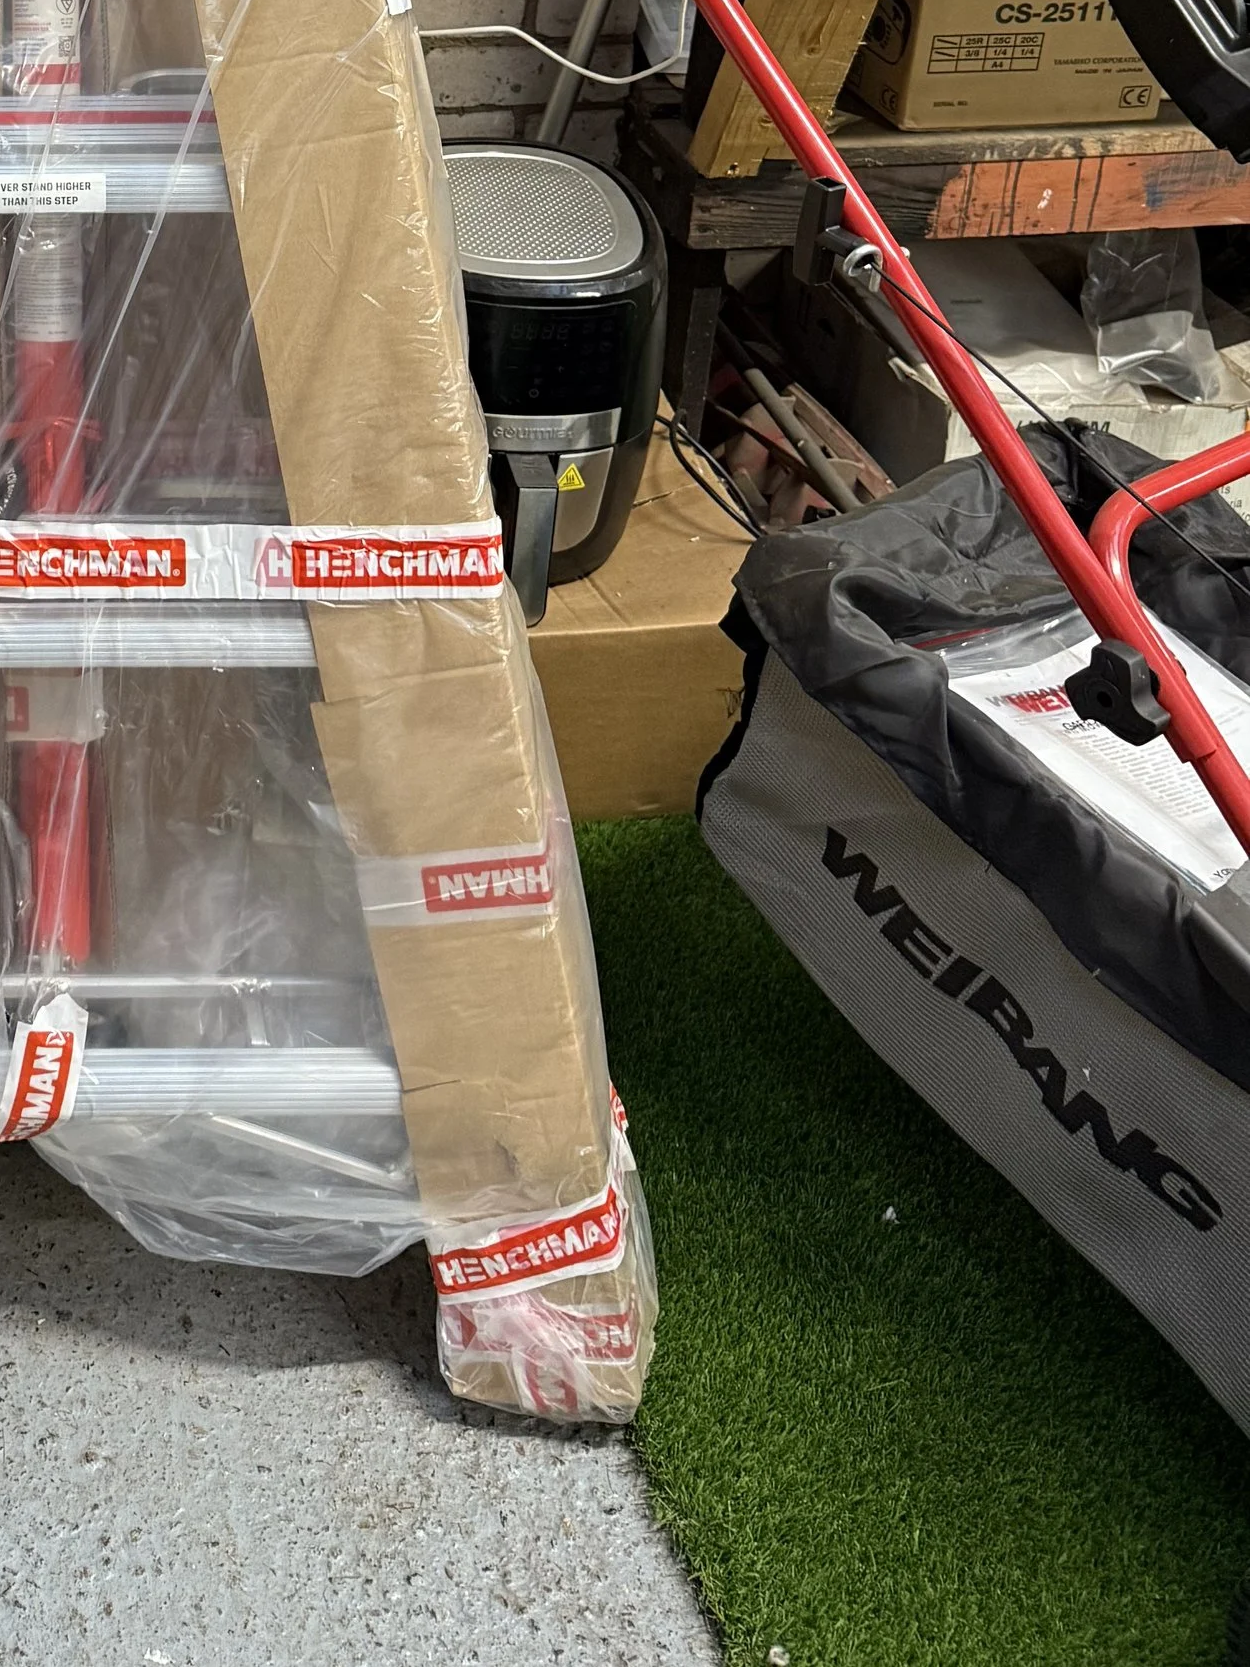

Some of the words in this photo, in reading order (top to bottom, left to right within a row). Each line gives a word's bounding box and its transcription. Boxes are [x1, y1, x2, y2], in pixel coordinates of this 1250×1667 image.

[995, 1, 1118, 24] CS-2511
[1020, 35, 1039, 44] 20C
[993, 48, 1007, 57] 1/4
[1020, 48, 1035, 56] 1/4
[21, 182, 53, 192] STAND
[56, 181, 91, 191] HIGHER
[2, 197, 28, 206] THAN
[54, 196, 79, 206] STEP
[305, 544, 503, 578] HENCHMAN
[438, 863, 550, 902] HMAN
[821, 824, 1224, 1233] WEIBANG
[437, 1210, 621, 1287] HENCHMAN
